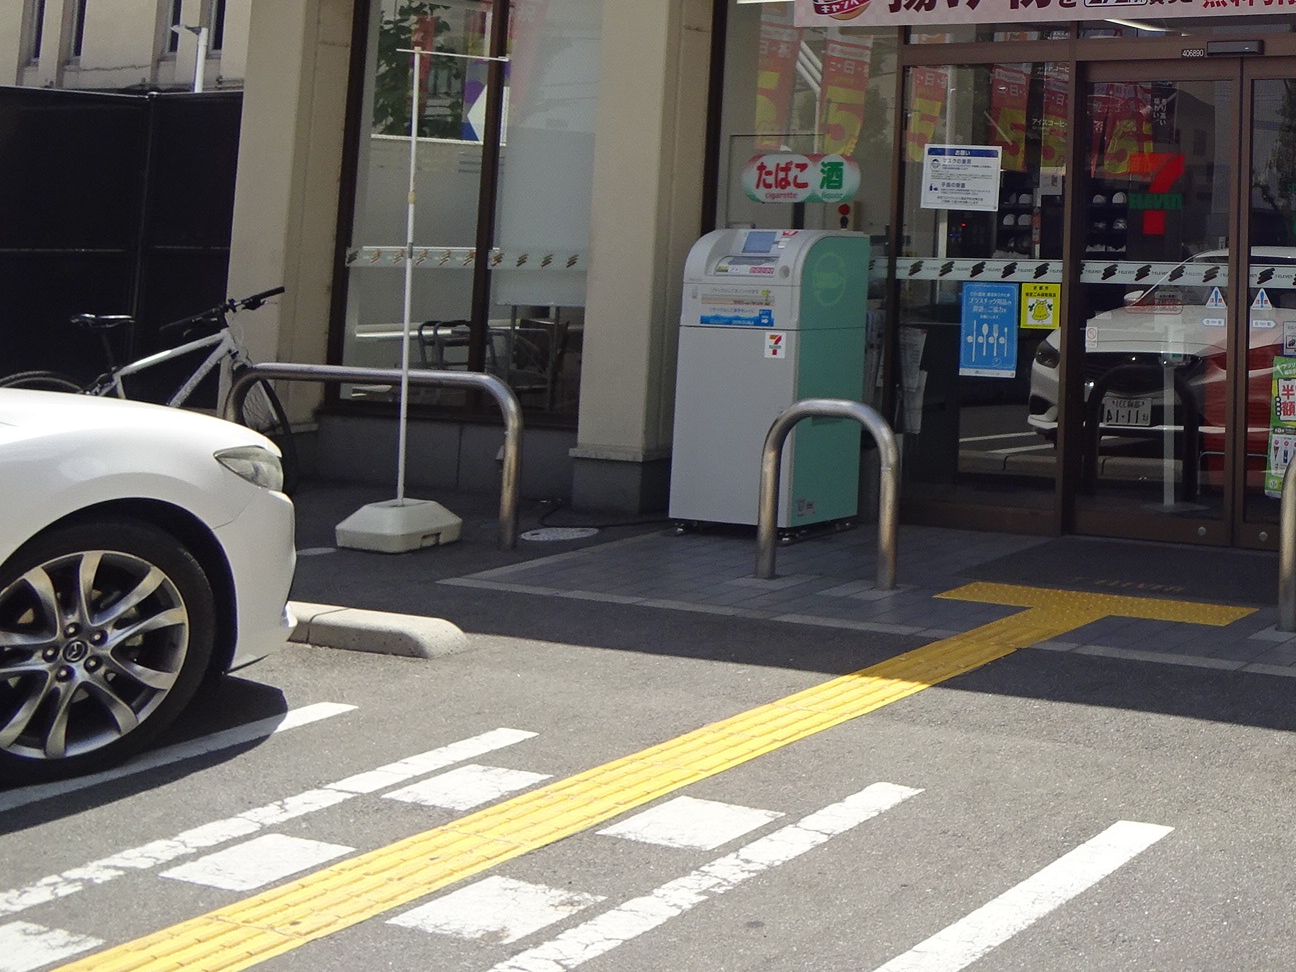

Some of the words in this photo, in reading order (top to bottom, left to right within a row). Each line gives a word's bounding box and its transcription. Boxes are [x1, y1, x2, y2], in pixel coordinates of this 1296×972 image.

[1032, 118, 1068, 128] アイスコーヒ
[755, 160, 809, 190] たばこ
[819, 161, 844, 190] 酒
